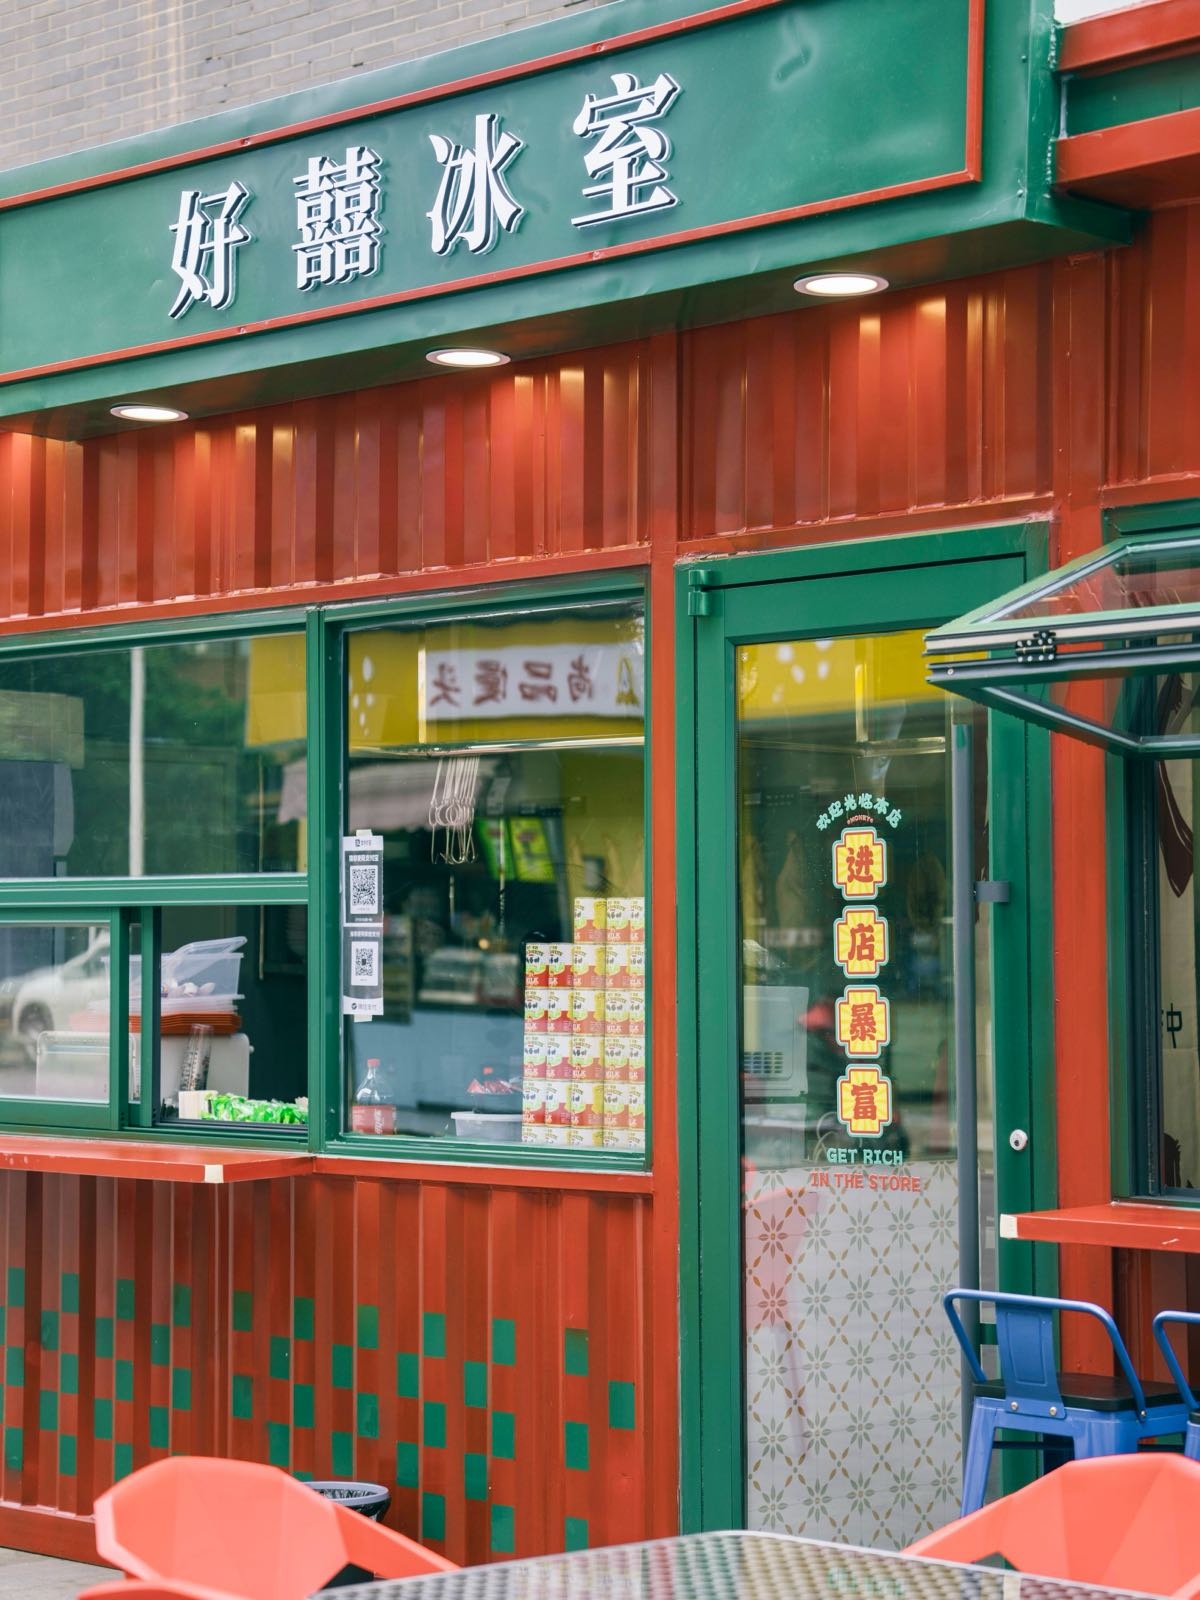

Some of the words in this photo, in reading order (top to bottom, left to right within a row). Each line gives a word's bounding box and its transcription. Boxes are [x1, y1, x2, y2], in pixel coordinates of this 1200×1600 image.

[816, 792, 902, 831] 欢迎光临本店
[846, 845, 878, 1121] 进店暴富
[826, 1148, 858, 1164] GET
[863, 1149, 904, 1166] RICH
[810, 1172, 829, 1187] IN
[834, 1173, 864, 1189] THE
[869, 1174, 922, 1192] STORE
